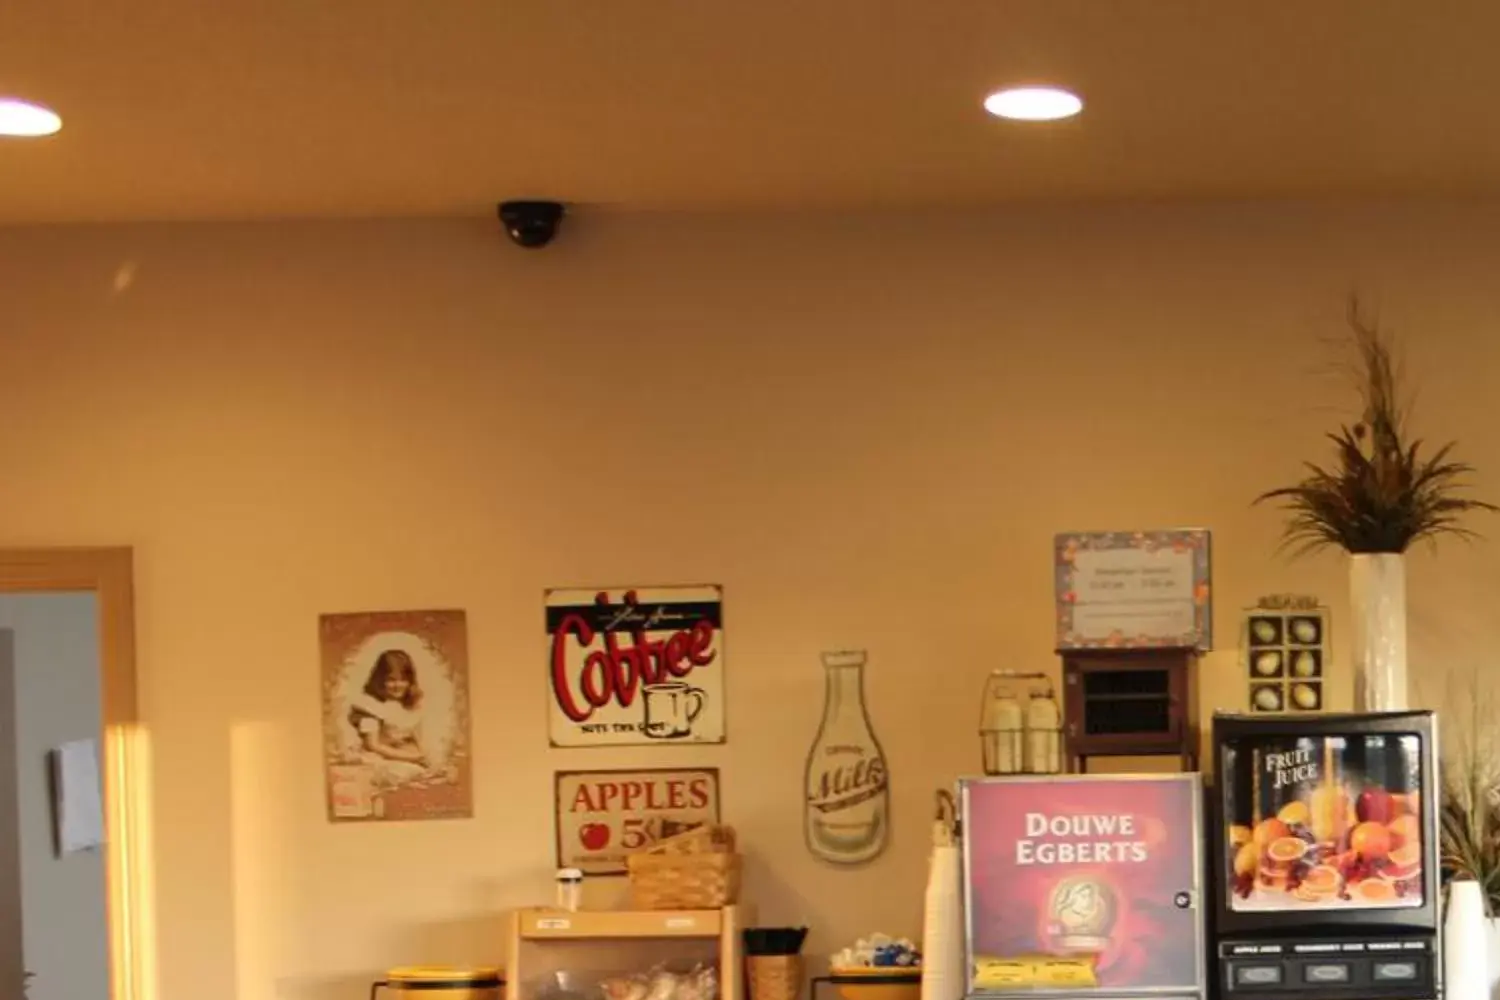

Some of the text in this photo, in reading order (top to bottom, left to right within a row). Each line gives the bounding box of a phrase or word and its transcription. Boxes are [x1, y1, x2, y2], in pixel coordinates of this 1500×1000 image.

[551, 590, 716, 722] Coffee
[1265, 749, 1311, 773] FRUIT
[807, 757, 884, 799] Milk
[1273, 763, 1318, 789] JUICE
[569, 779, 709, 813] APPLES
[1025, 813, 1136, 837] DOUWE
[1015, 840, 1148, 865] EGBERTS
